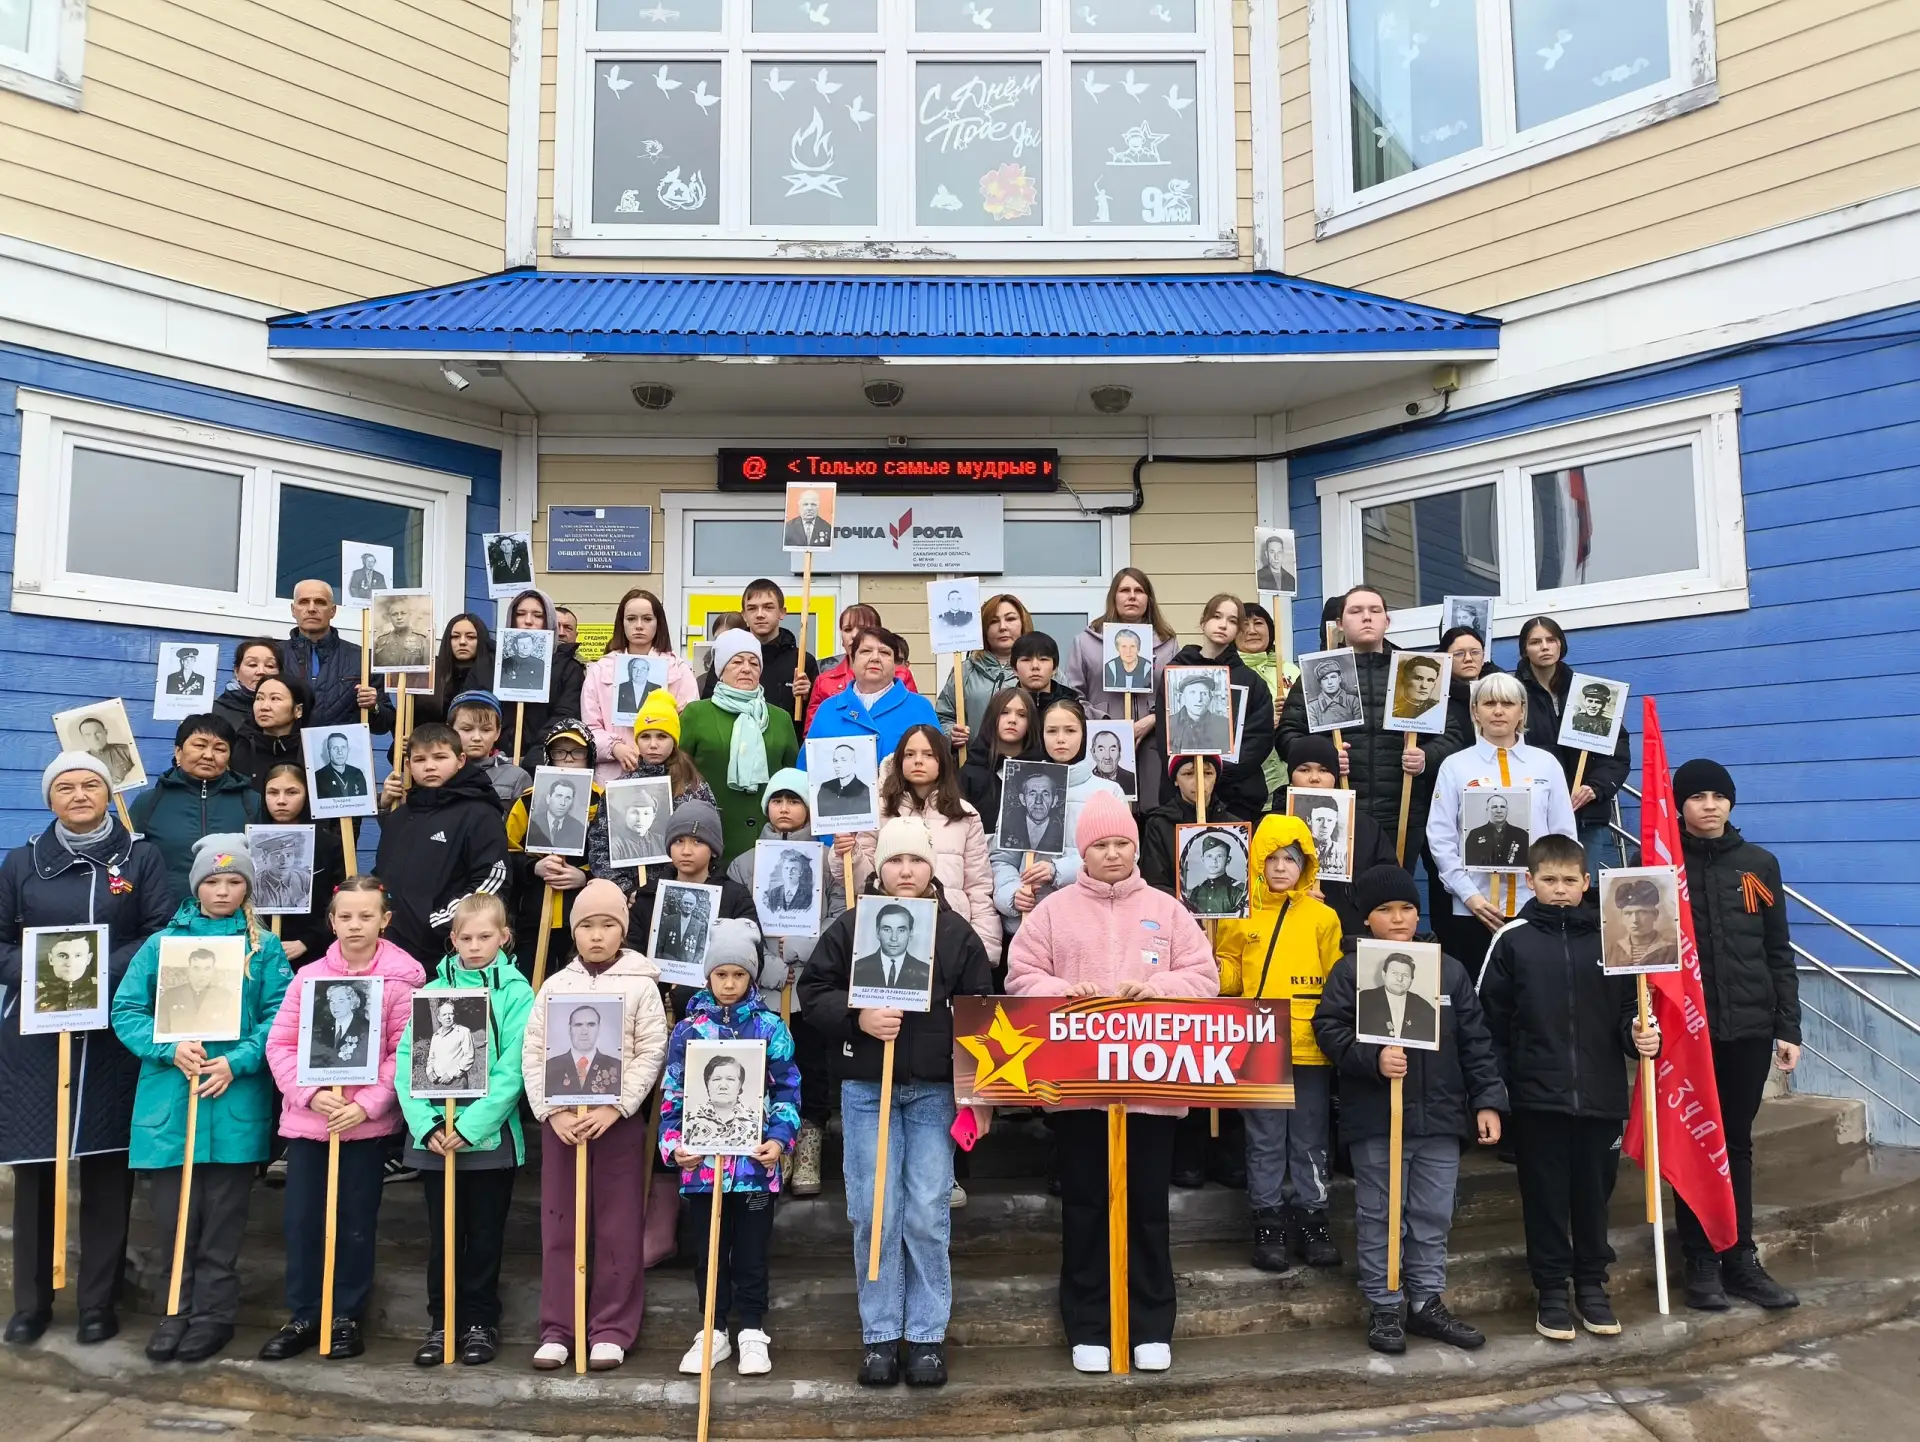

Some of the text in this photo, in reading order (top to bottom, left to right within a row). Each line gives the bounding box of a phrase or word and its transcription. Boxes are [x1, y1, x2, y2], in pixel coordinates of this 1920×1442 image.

[1140, 186, 1161, 223] 9
[807, 456, 877, 476] Только
[884, 460, 950, 476] самые
[957, 460, 1036, 480] мудрые
[912, 526, 964, 539] РОСТА
[852, 992, 885, 1000] Василий
[1049, 1007, 1277, 1043] БЕССМЕРТНЫЙ
[1097, 1043, 1238, 1085] ПОЛК
